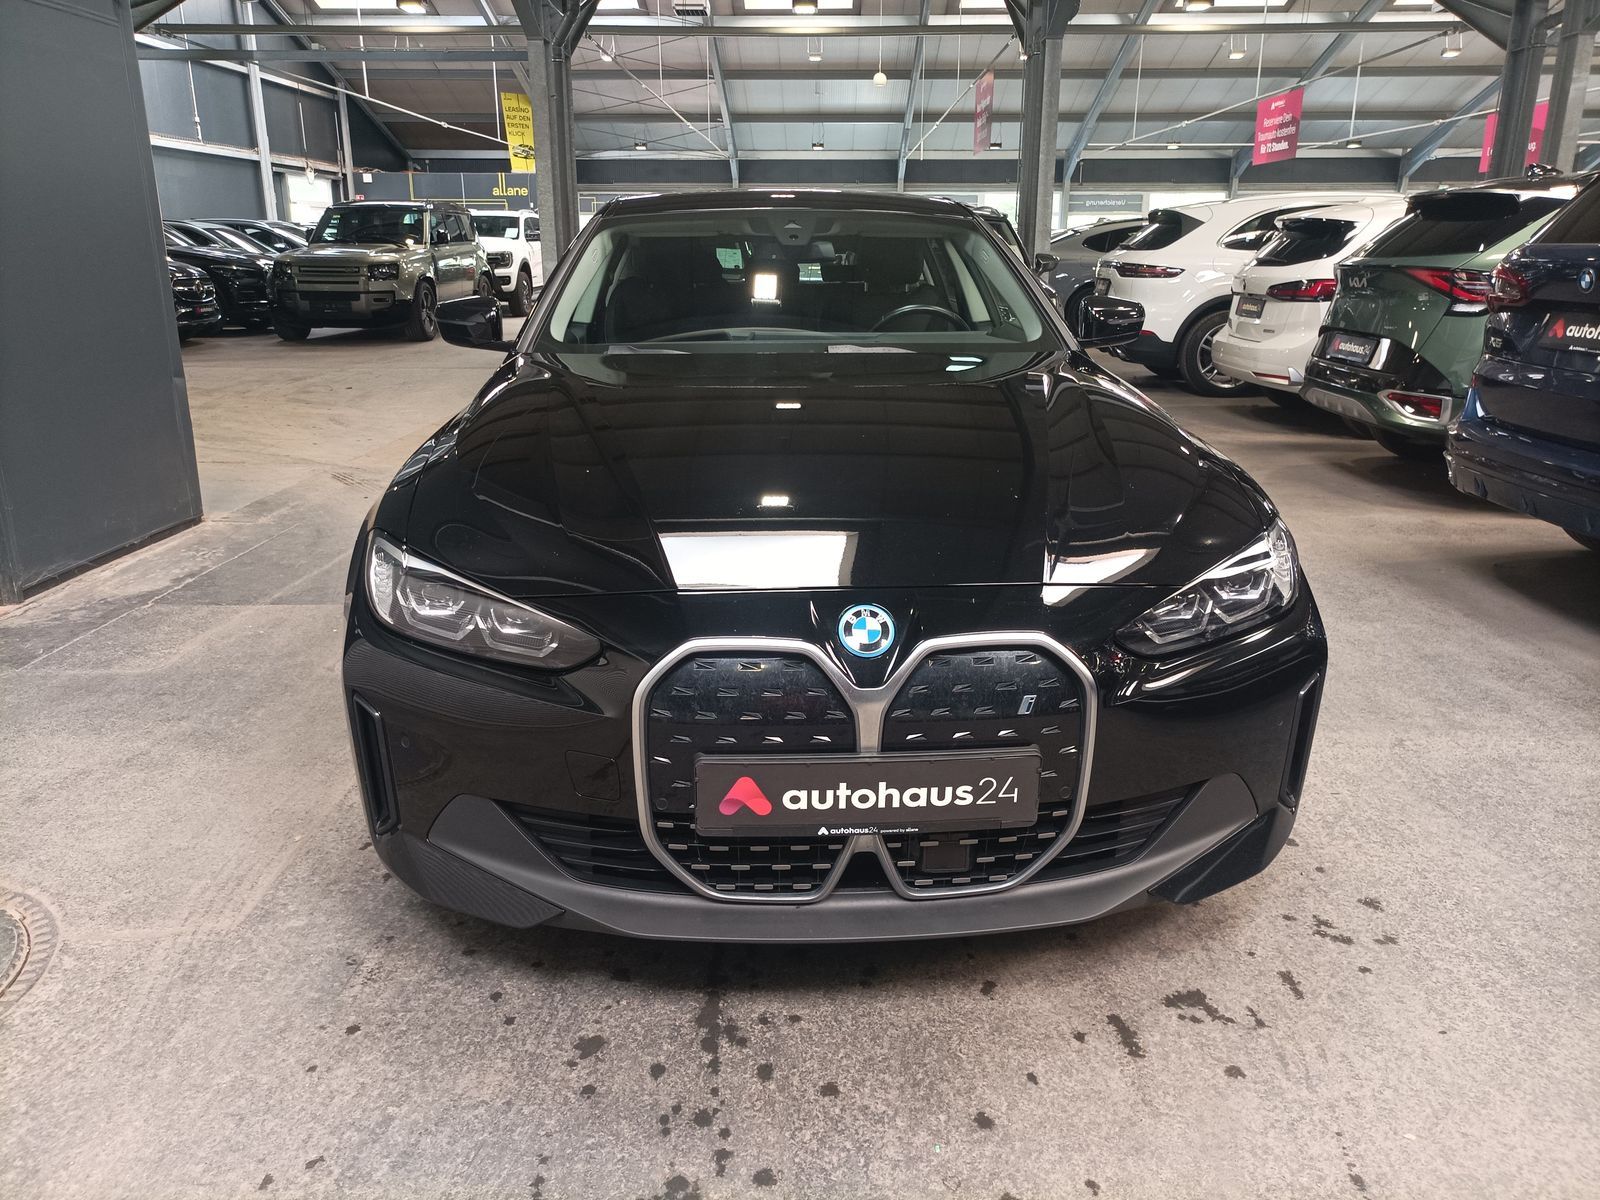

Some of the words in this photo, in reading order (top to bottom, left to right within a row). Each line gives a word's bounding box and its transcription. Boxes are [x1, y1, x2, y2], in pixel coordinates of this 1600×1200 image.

[507, 122, 530, 130] ERSTEN
[492, 172, 529, 196] allane
[782, 775, 1018, 811] autohaus24
[830, 826, 878, 835] autohaus24
